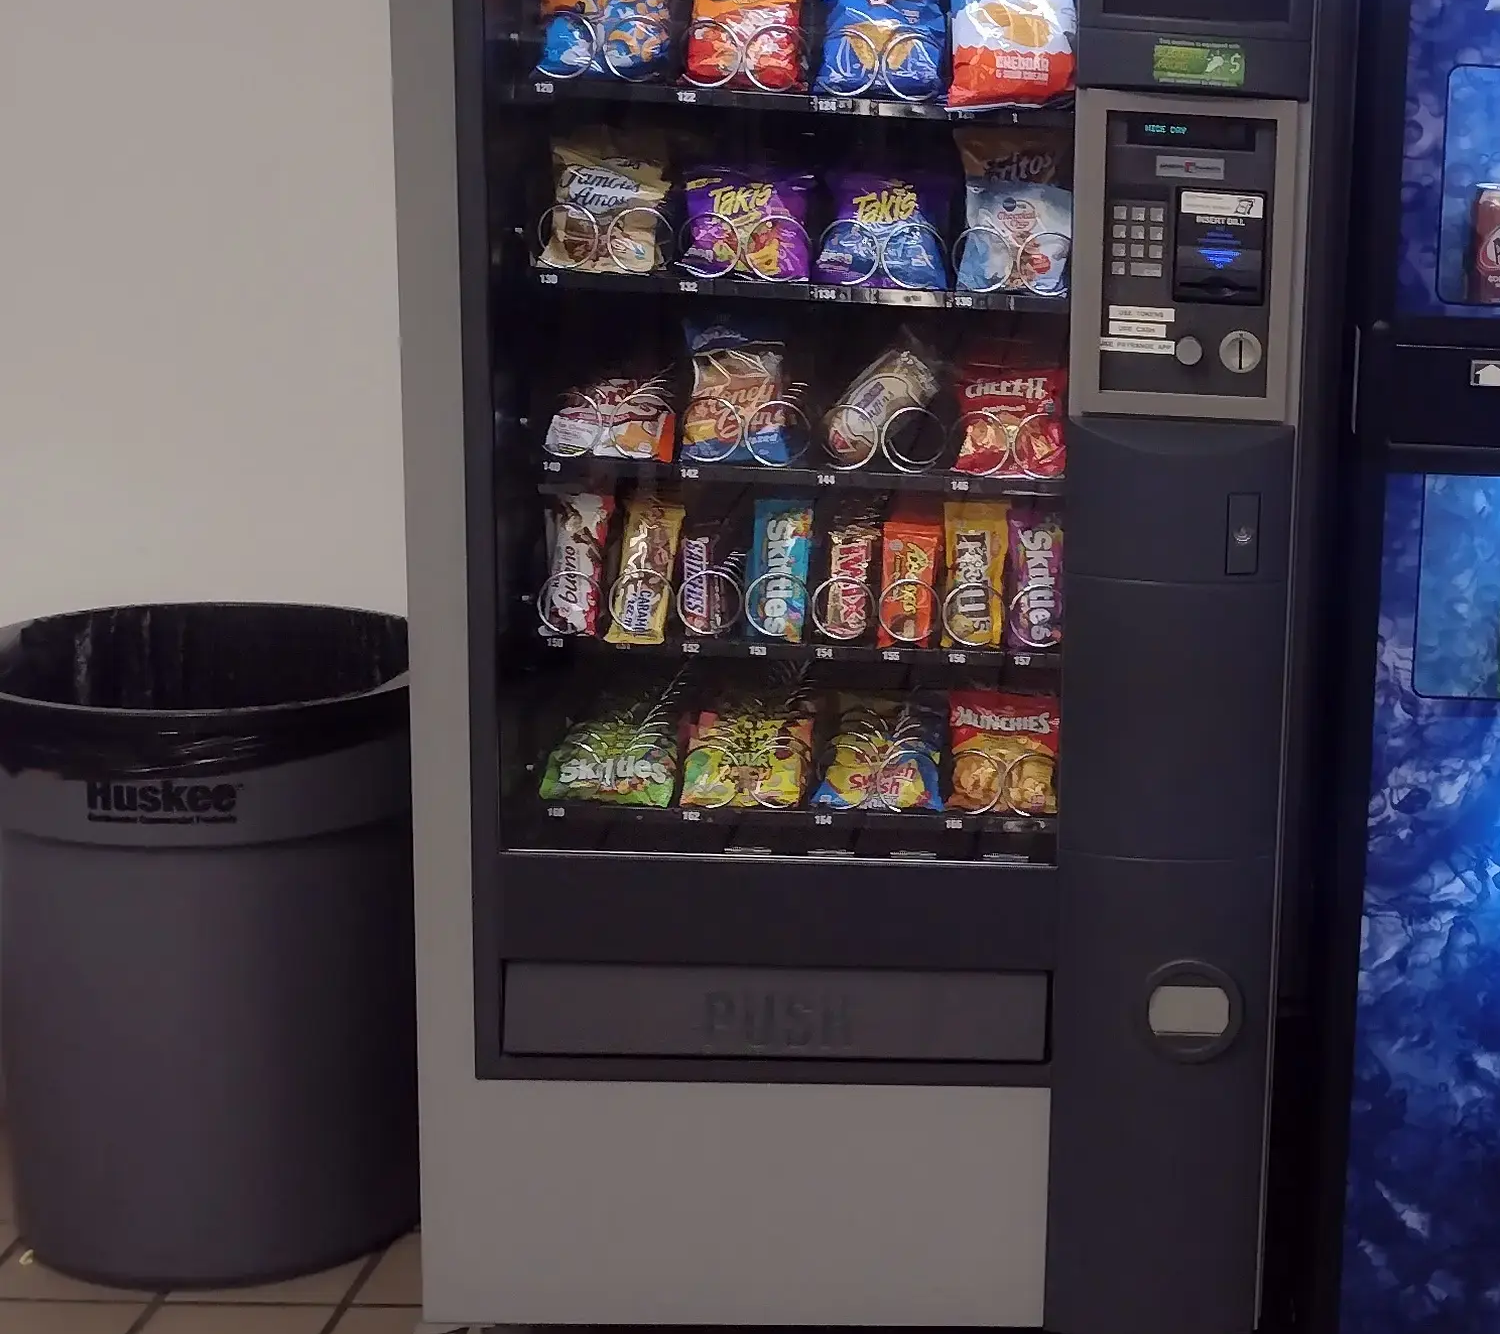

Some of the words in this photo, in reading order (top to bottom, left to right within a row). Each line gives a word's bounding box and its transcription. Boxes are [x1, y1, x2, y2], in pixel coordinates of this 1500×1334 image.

[1144, 124, 1167, 133] NICE
[1170, 126, 1188, 134] DAY
[708, 183, 774, 216] Takis
[852, 187, 918, 224] Takis
[1195, 215, 1226, 224] INSERT
[1226, 218, 1245, 226] BILL
[558, 545, 577, 604] bueno
[766, 518, 795, 634] Skittles
[839, 540, 872, 623] TWIX
[1018, 529, 1055, 641] Skittles
[958, 705, 1051, 735] MUNCHIES
[559, 755, 667, 784] Skittles
[87, 780, 237, 813] Huskee
[703, 989, 855, 1051] PUSH
